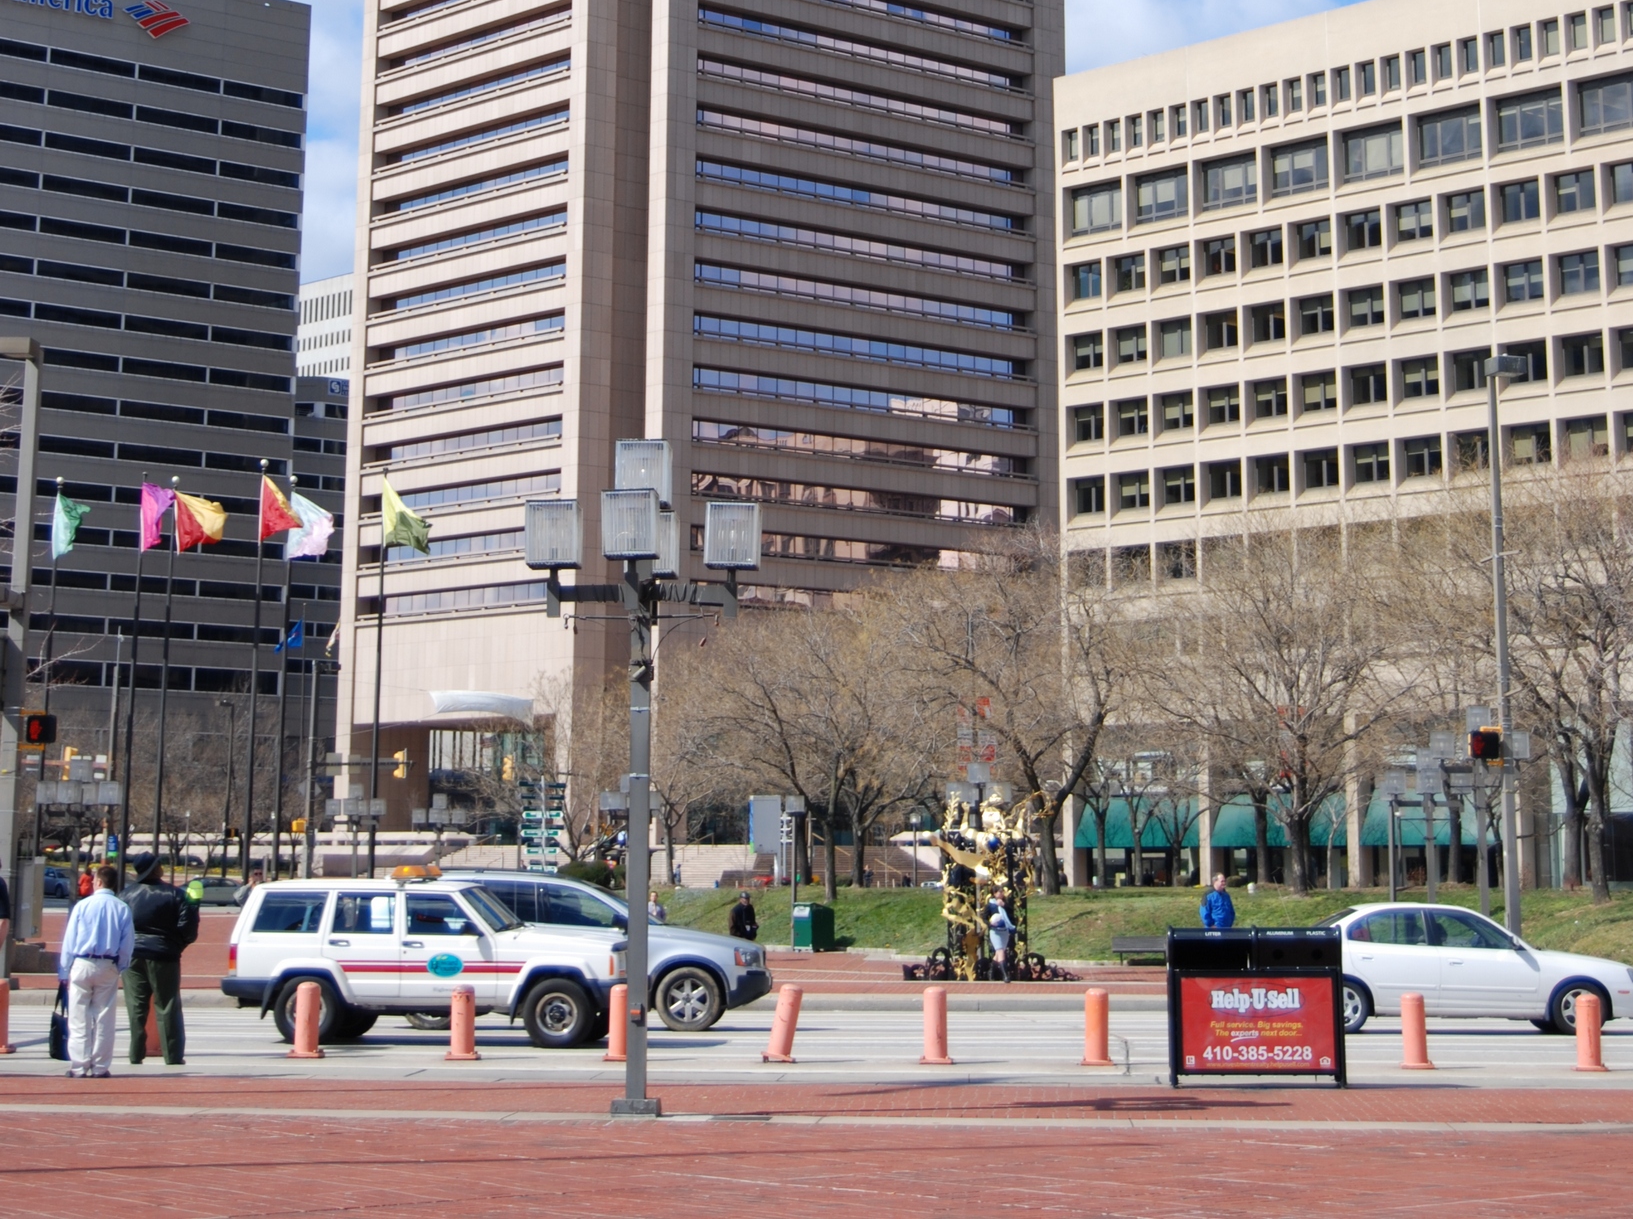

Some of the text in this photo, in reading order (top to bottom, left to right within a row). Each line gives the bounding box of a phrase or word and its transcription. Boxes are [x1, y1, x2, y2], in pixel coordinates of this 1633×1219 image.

[1210, 1020, 1225, 1028] Full
[1257, 1020, 1271, 1030] Big
[1272, 1021, 1303, 1030] savings.
[1215, 1029, 1229, 1037] The
[1230, 1030, 1259, 1038] experts
[1260, 1029, 1277, 1037] next
[1203, 1045, 1312, 1060] 410-385-5228
